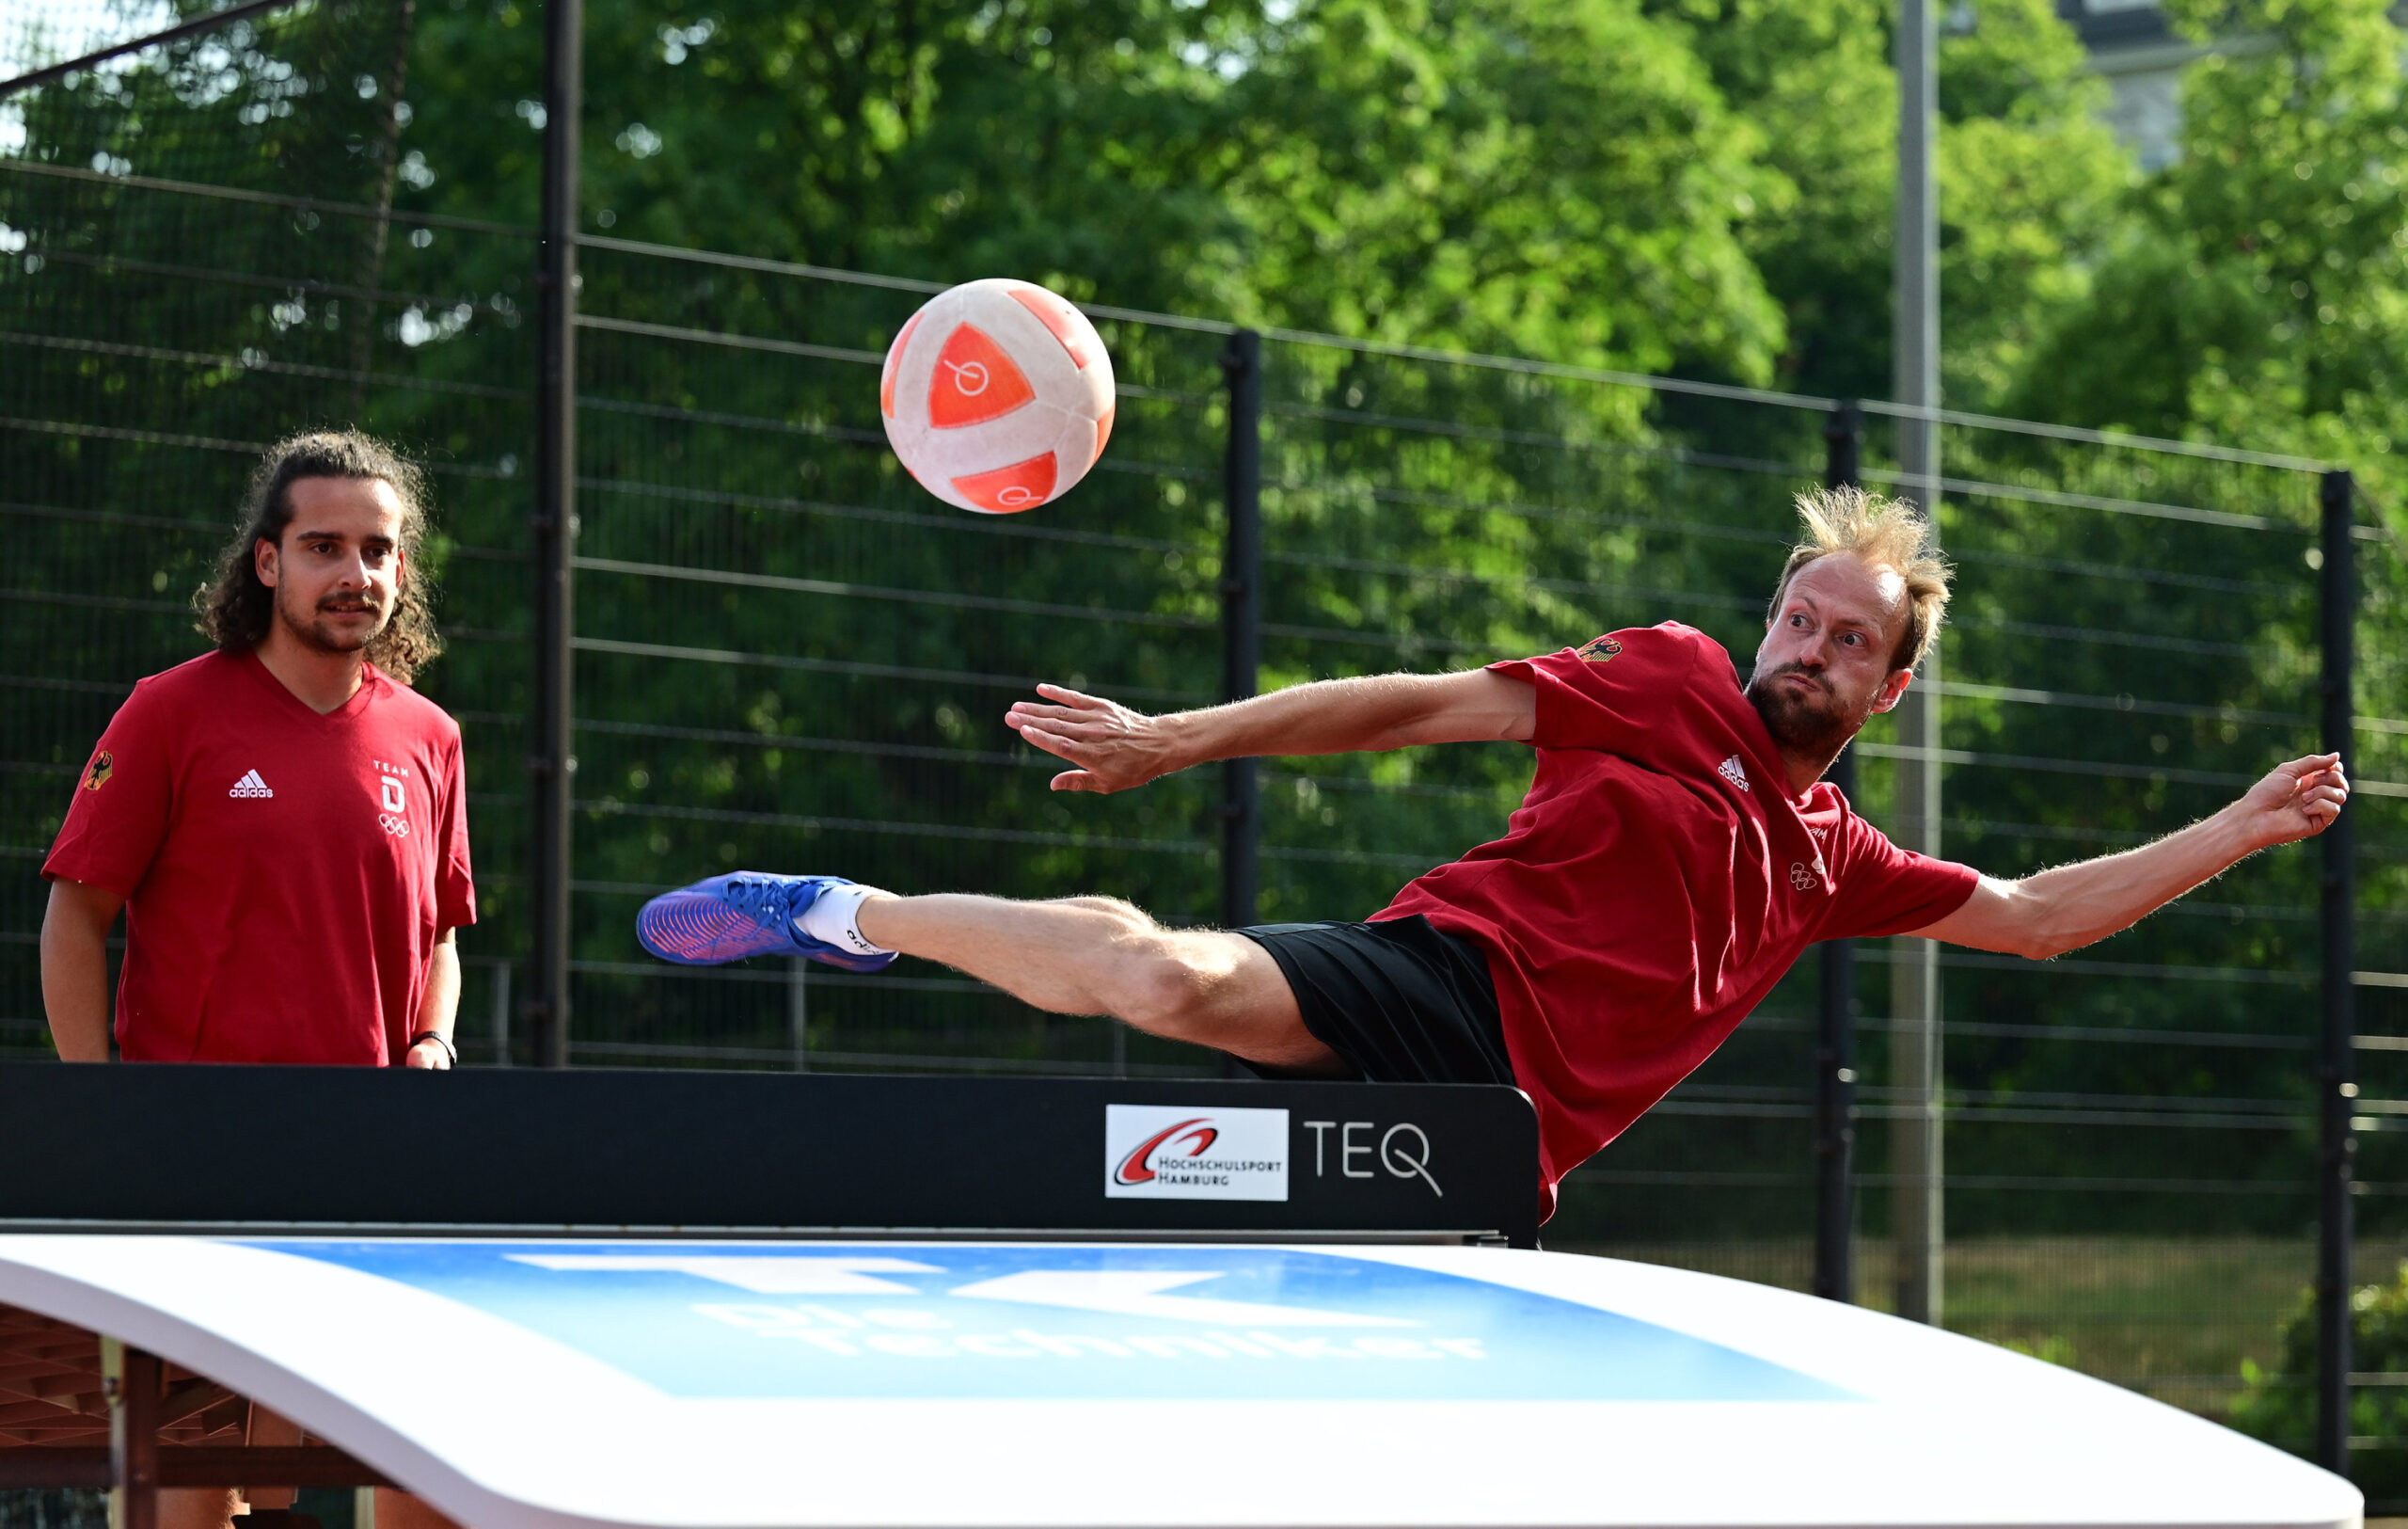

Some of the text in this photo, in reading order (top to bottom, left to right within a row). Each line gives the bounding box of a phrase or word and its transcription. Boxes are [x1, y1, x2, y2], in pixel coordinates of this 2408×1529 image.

[373, 760, 409, 777] TEAM
[1718, 765, 1750, 792] adidas
[229, 787, 274, 798] adidas
[1158, 1155, 1282, 1172] HOCHSCHULSPORT
[1304, 1121, 1443, 1197] TEQ
[1158, 1172, 1229, 1187] HAMBURG
[501, 1253, 1431, 1327] TK
[689, 1302, 957, 1329] Die
[755, 1328, 1490, 1359] Techniker
